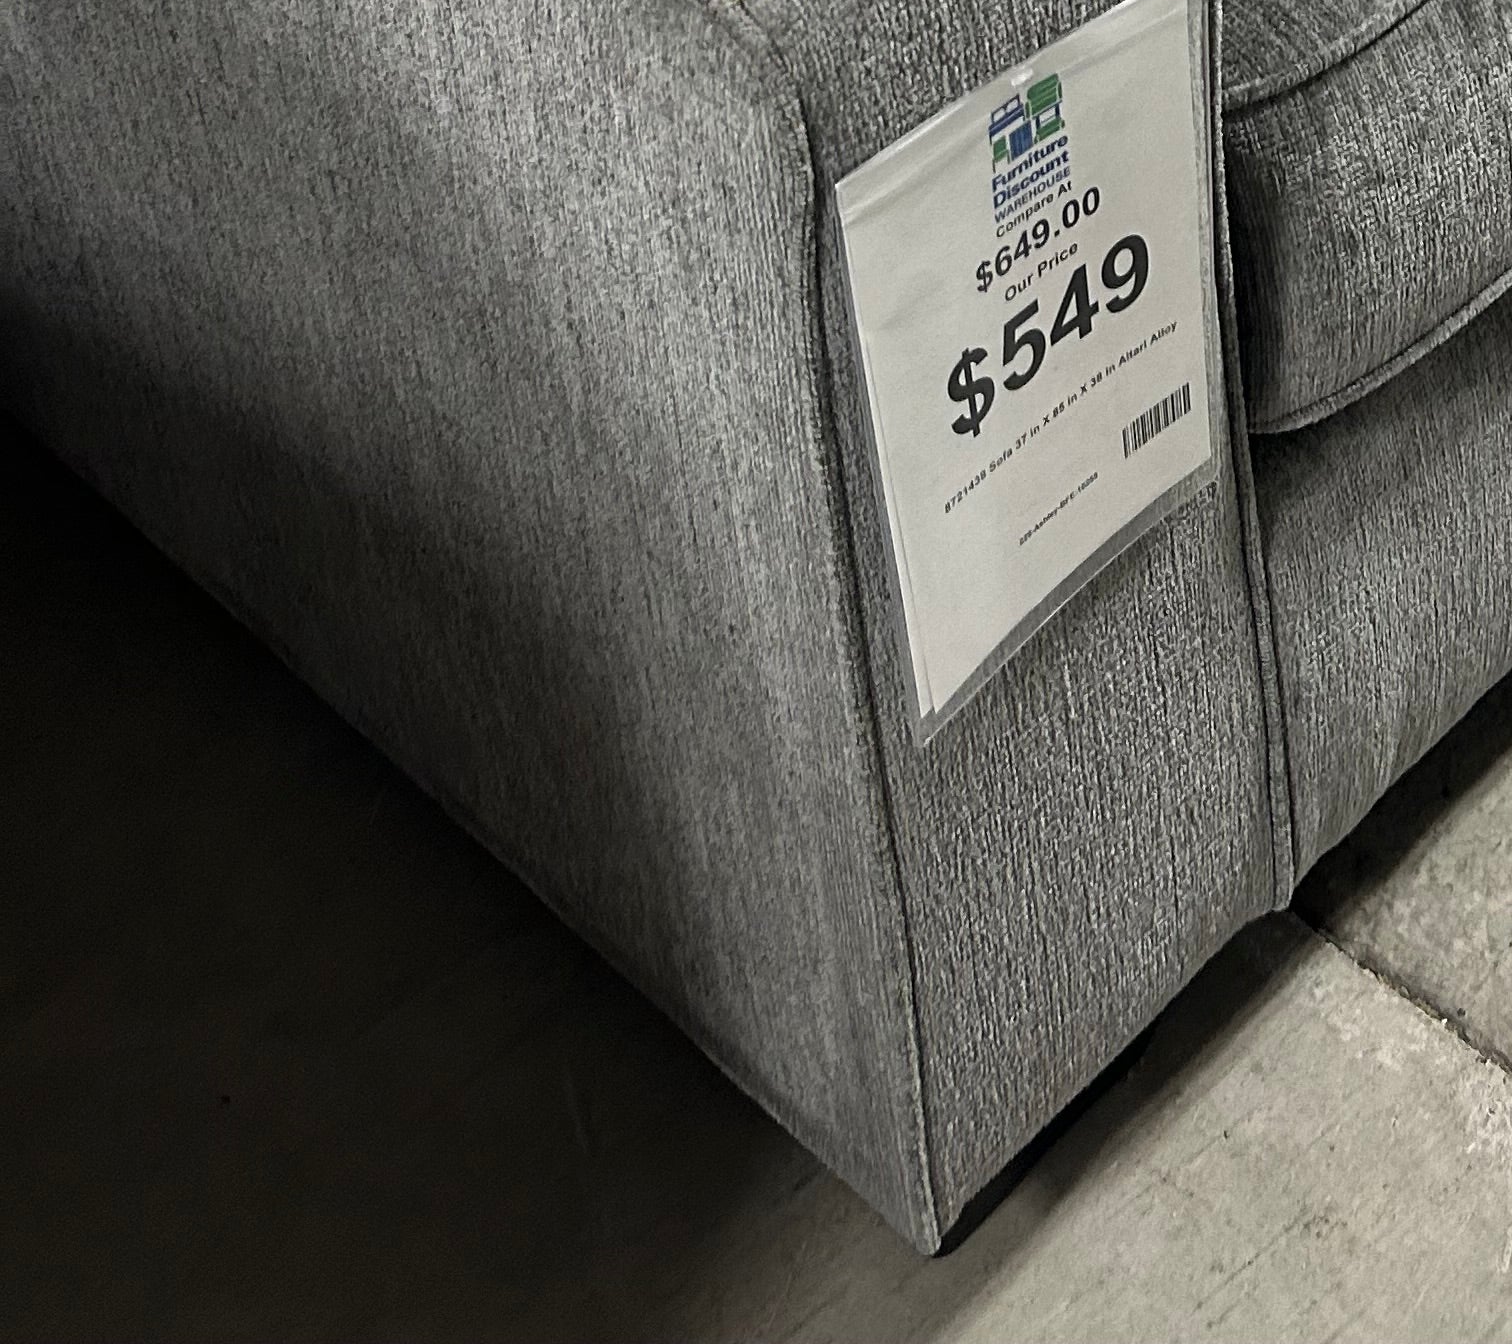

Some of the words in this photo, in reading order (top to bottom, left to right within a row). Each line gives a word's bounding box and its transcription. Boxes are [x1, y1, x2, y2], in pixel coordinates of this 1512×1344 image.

[992, 136, 1068, 192] Furniture
[993, 151, 1069, 209] Discount
[994, 166, 1071, 223] WAREHOUSE
[996, 193, 1053, 238] Compare
[1057, 181, 1072, 199] At
[976, 187, 1100, 293] $649.00
[1005, 273, 1033, 301] Our
[1038, 243, 1078, 278] Price
[947, 234, 1150, 438] $549
[989, 447, 1013, 473] Sofa
[1015, 434, 1027, 450] 37
